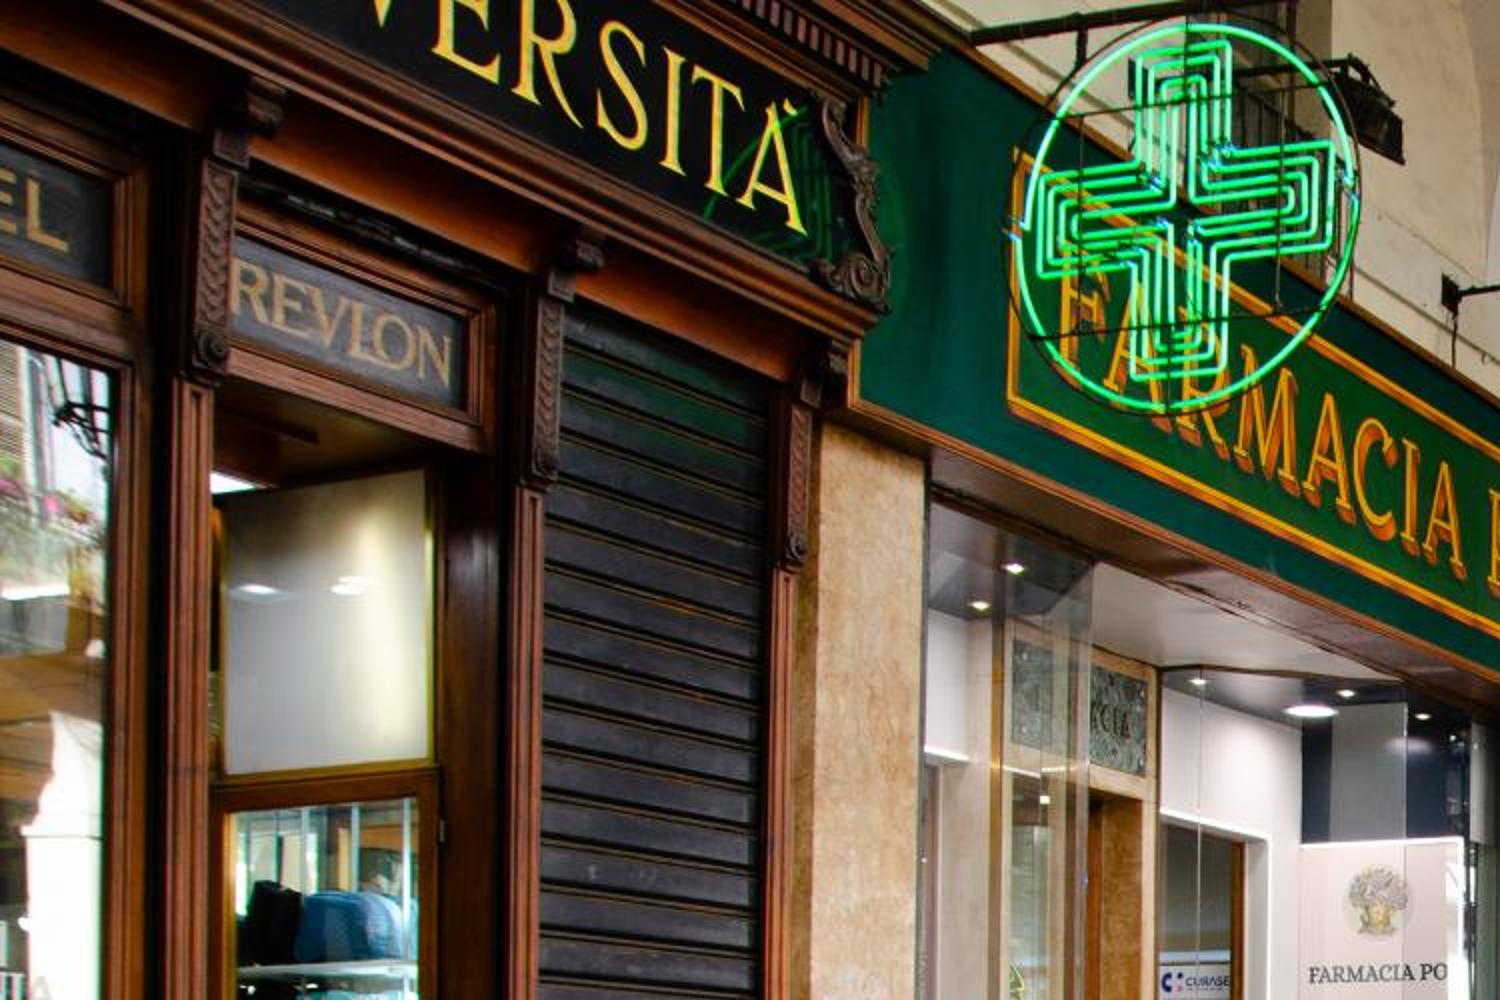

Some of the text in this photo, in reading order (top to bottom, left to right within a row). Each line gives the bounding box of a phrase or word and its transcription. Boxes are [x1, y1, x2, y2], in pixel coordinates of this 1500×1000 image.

[371, 0, 807, 236] ERSITÀ
[230, 256, 452, 389] REVLON
[1309, 963, 1448, 985] FARMACIA PO
